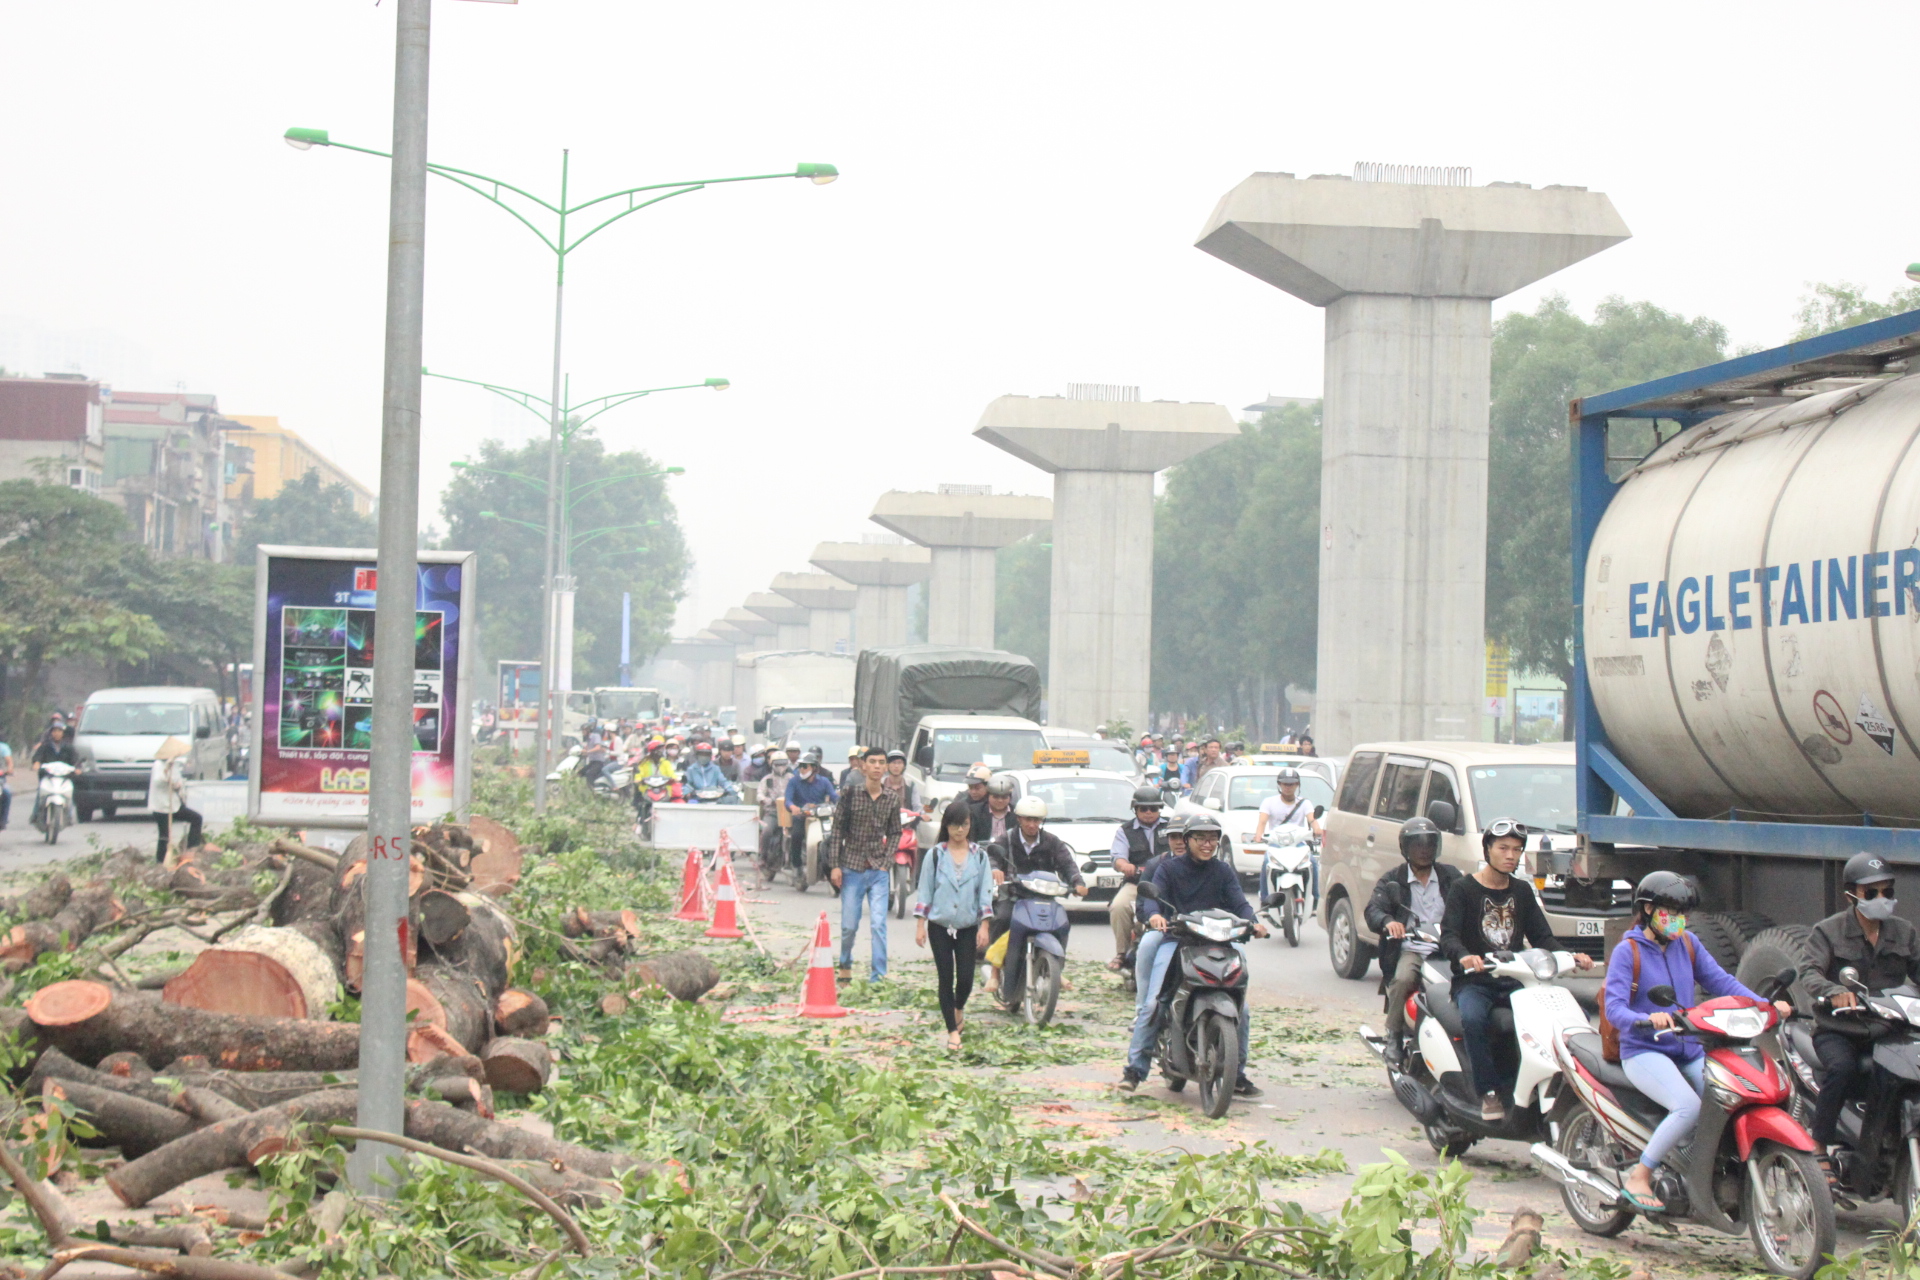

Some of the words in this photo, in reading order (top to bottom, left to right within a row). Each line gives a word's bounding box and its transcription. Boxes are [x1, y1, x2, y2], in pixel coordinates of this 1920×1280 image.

[335, 592, 350, 603] 3T
[1629, 548, 1920, 639] EAGLETAINER
[1864, 720, 1888, 733] 2586
[320, 767, 370, 792] LAS
[373, 835, 404, 861] R5
